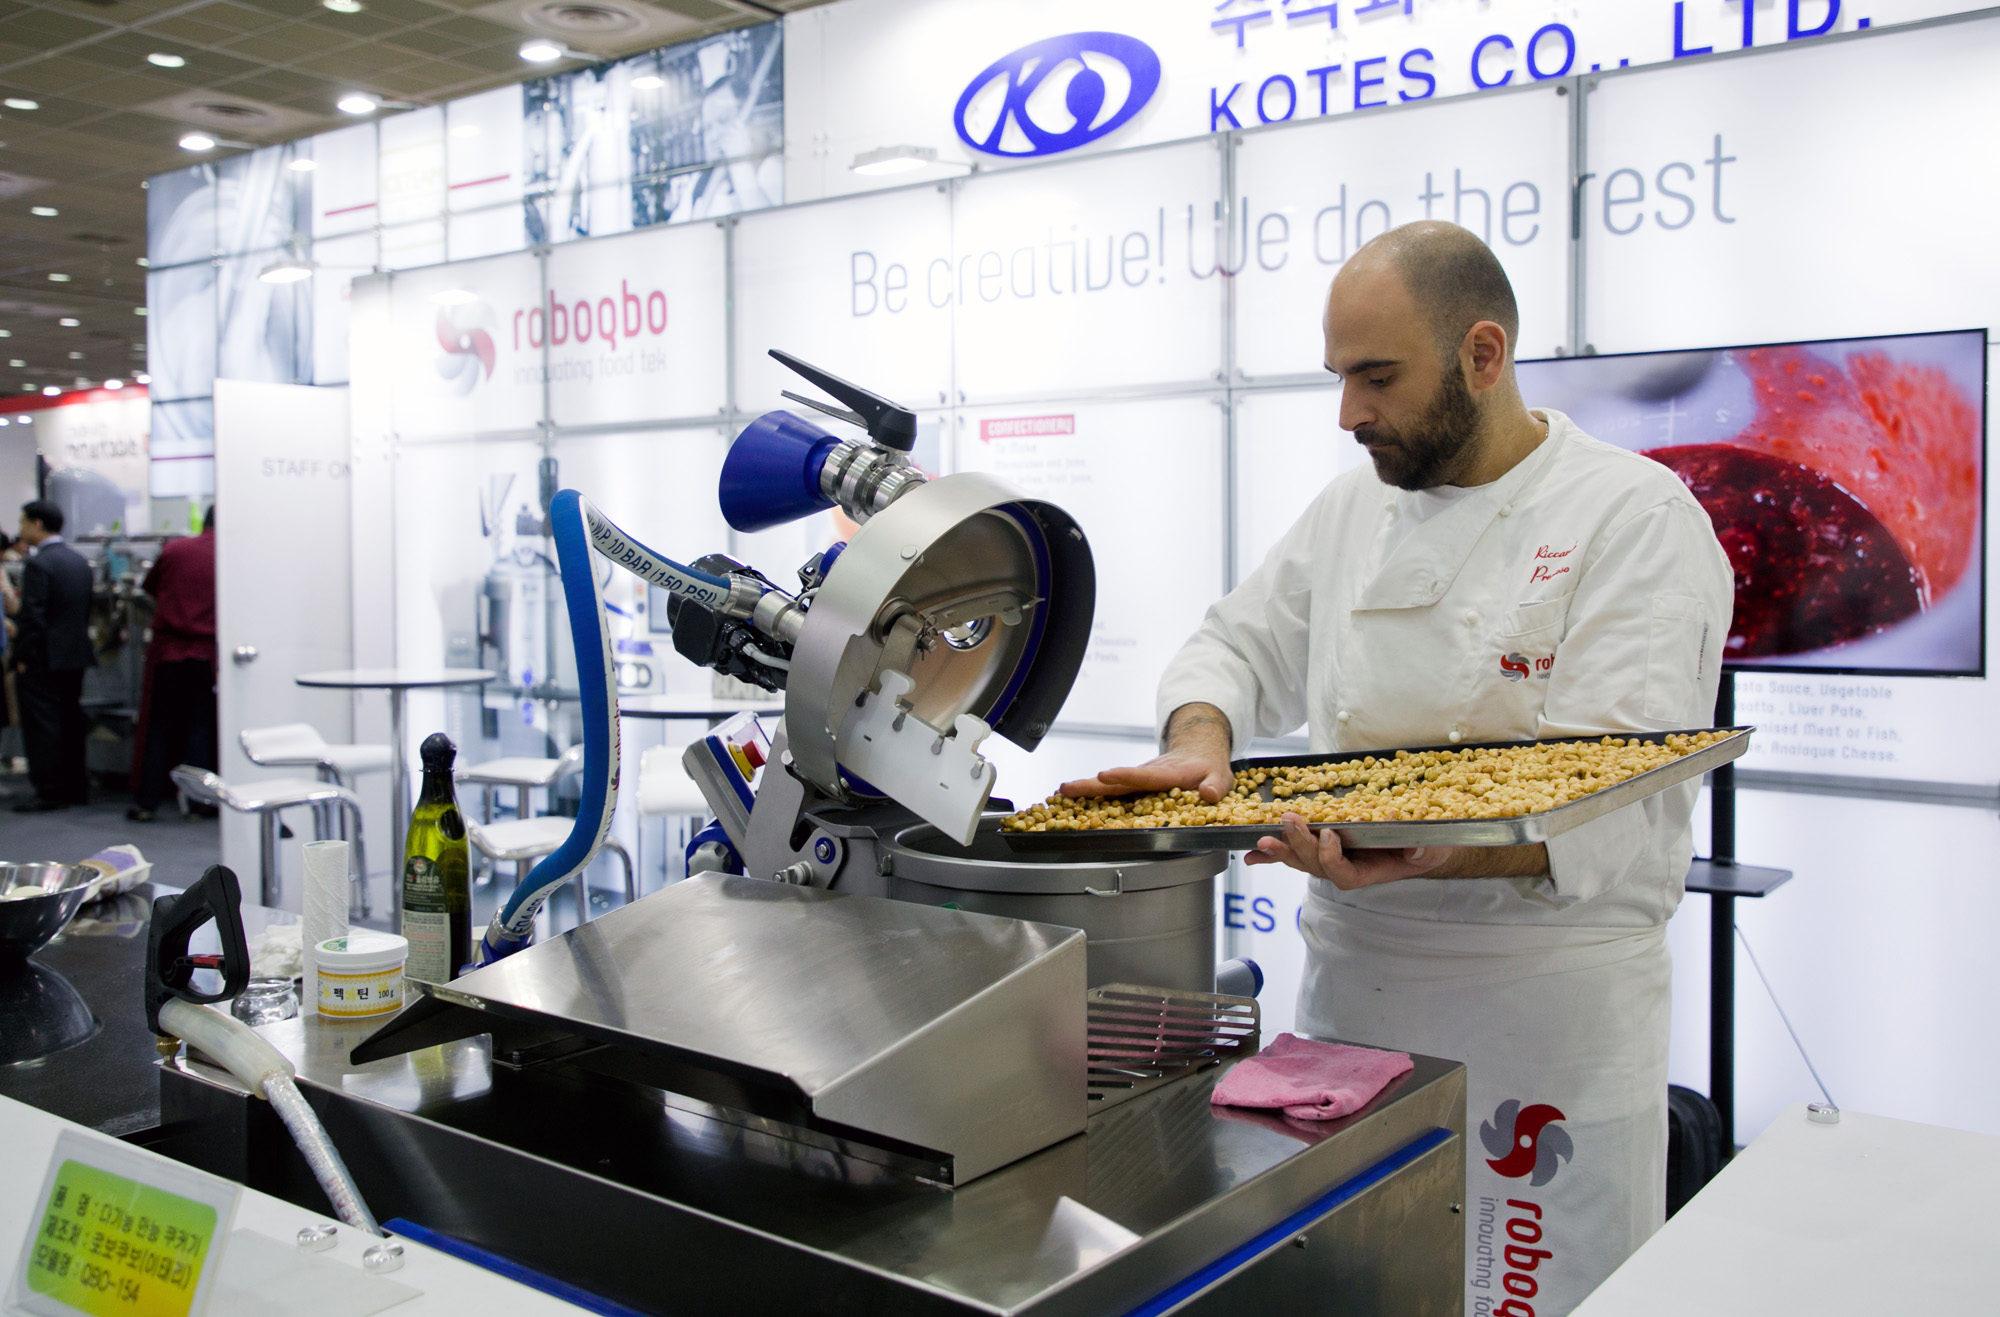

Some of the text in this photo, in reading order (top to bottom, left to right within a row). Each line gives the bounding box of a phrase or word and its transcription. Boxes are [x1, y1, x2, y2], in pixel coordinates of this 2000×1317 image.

[1210, 47, 1437, 132] KOTES
[1673, 0, 1871, 60] LTD.
[851, 250, 908, 318] Be
[1187, 196, 1290, 280] We
[1417, 168, 1541, 247] the
[1571, 133, 1737, 241] rest
[513, 279, 668, 352] roboqbo
[261, 457, 322, 478] STAFF
[619, 547, 653, 576] BAR
[1768, 681, 1814, 697] Sauce,
[1803, 723, 1841, 738] Meat
[1846, 726, 1862, 738] or
[1867, 724, 1904, 743] Fish,
[1770, 742, 1837, 762] Analogue
